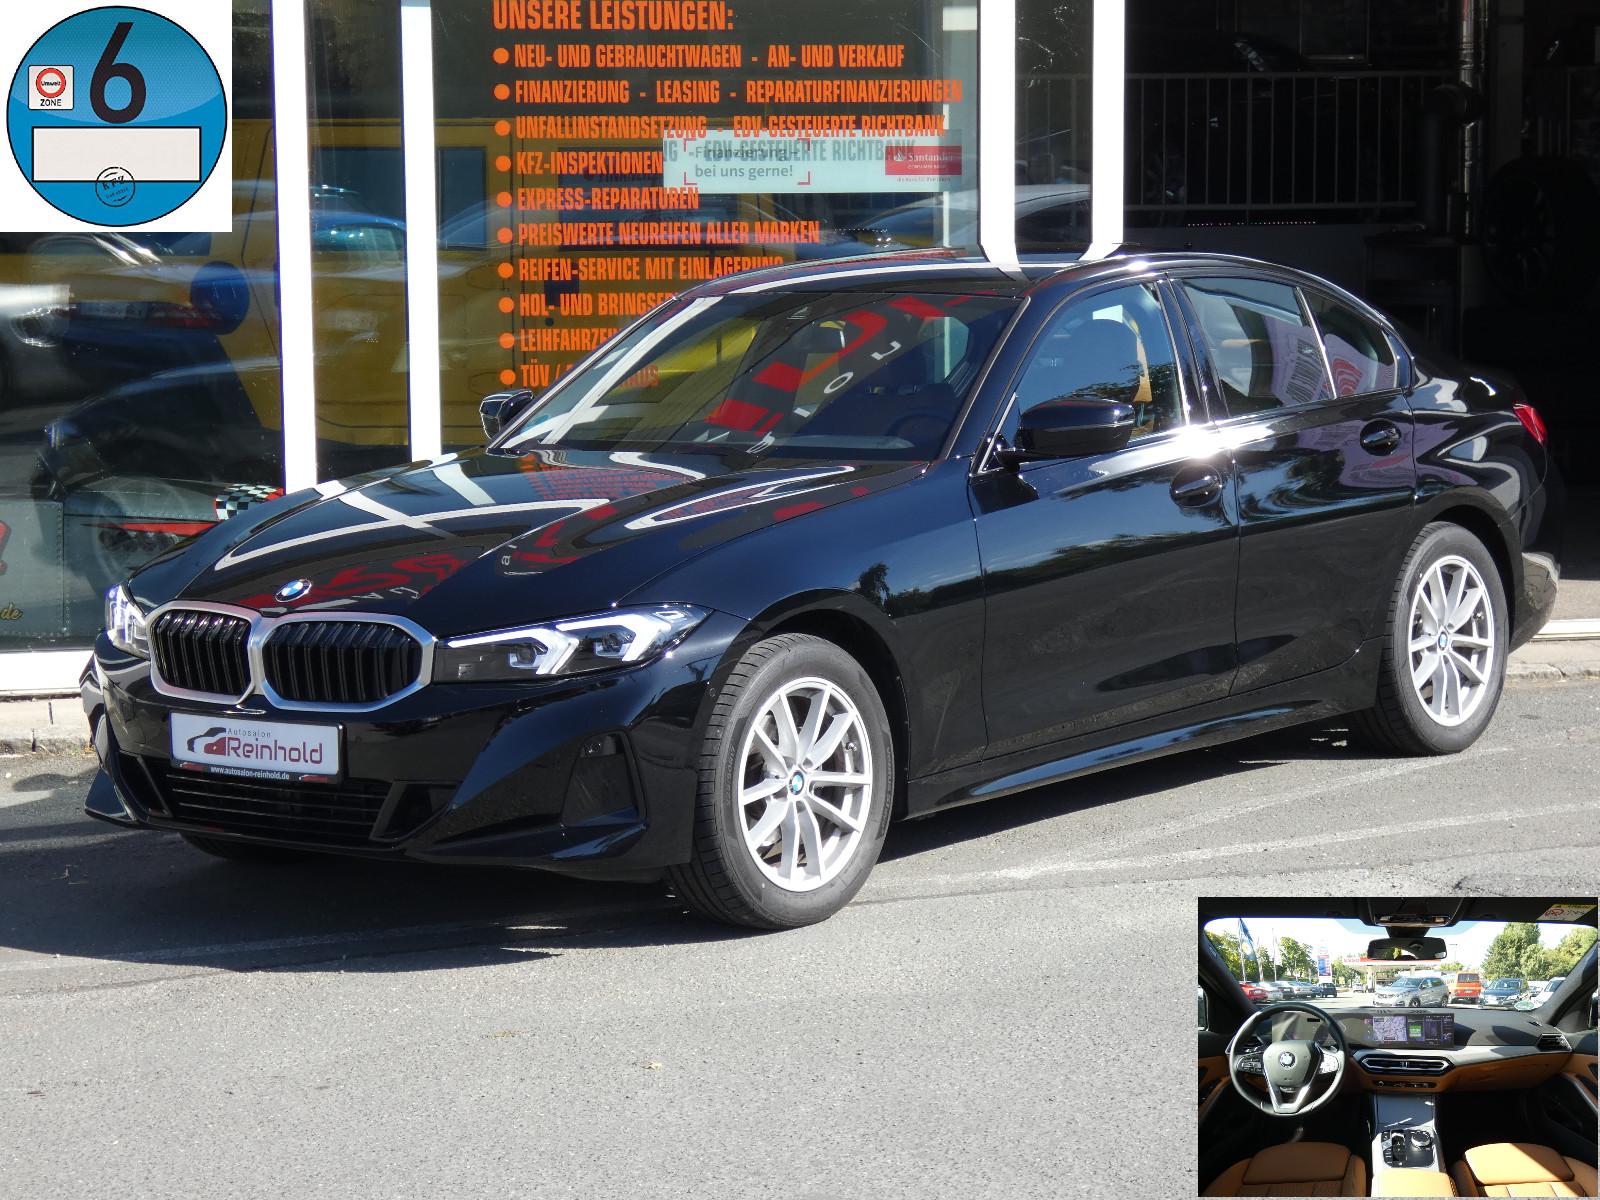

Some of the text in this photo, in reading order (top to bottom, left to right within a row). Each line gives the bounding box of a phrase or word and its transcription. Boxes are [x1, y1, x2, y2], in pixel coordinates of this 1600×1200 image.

[493, 0, 734, 30] UNSERE LEISTUNGEN:
[514, 44, 553, 68] NEU-
[557, 44, 591, 68] UND
[595, 44, 742, 68] GEBRAUCHTWAGEN
[767, 44, 797, 68] AN-
[801, 44, 834, 68] UND
[838, 44, 905, 68] VERKAUF
[515, 79, 630, 103] FINANZIERUNG
[656, 79, 720, 103] LEASING
[746, 79, 963, 103] REPARATURFINANZIERUNGEN
[516, 115, 707, 139] UNFALLINSTANDSETZUNG
[733, 115, 857, 138] EDV-GESTEUERTE
[861, 114, 945, 138] RICHTBANK
[516, 151, 663, 175] KFZ-INSPEKTIONEN
[695, 146, 787, 162] Finanzierung
[695, 164, 793, 181] bei uns gerne!
[517, 186, 700, 211] EXPRESS-REPARATUREN
[518, 220, 820, 246] PREISWERTE NEUREIFEN ALLER MARKEN
[518, 257, 641, 281] REIFEN-SERVICE
[645, 257, 675, 280] MIT
[519, 293, 556, 316] HOL-
[559, 292, 593, 316] UND
[520, 358, 550, 388] TÜV
[228, 727, 271, 738] Autosalon
[227, 737, 323, 765] Reinhold
[210, 766, 290, 780] www.autosalon-reinhold.de
